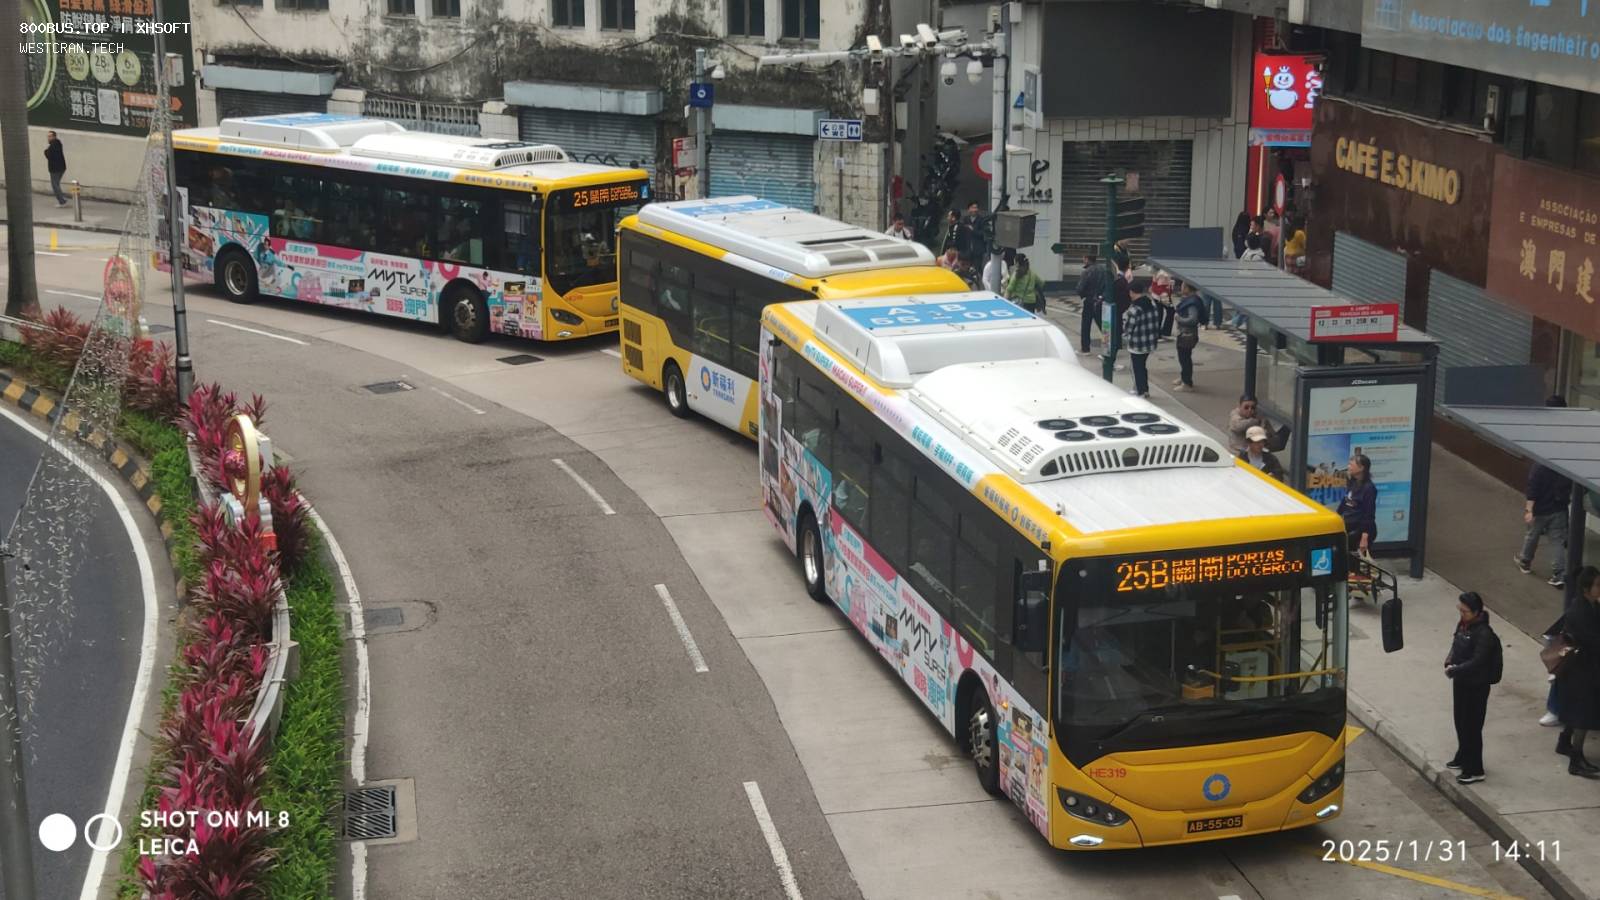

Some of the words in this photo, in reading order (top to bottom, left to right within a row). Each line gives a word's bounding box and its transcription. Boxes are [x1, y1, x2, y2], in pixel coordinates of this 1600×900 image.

[1487, 22, 1512, 45] dos
[1336, 136, 1378, 180] CAFÉ
[574, 191, 588, 207] 25
[1540, 198, 1598, 225] ASSOCIAÇÃO
[1519, 211, 1525, 222] E
[1530, 215, 1577, 239] EMPRESAS
[1584, 231, 1597, 245] DE
[400, 286, 427, 296] SUPER
[1227, 550, 1285, 563] PORTAS
[1117, 559, 1169, 592] 25B
[1227, 566, 1247, 577] DO
[1252, 561, 1303, 576] CERCO
[924, 651, 945, 681] SUPER
[1089, 767, 1127, 778] HE319
[1188, 816, 1242, 832] AB-55-05
